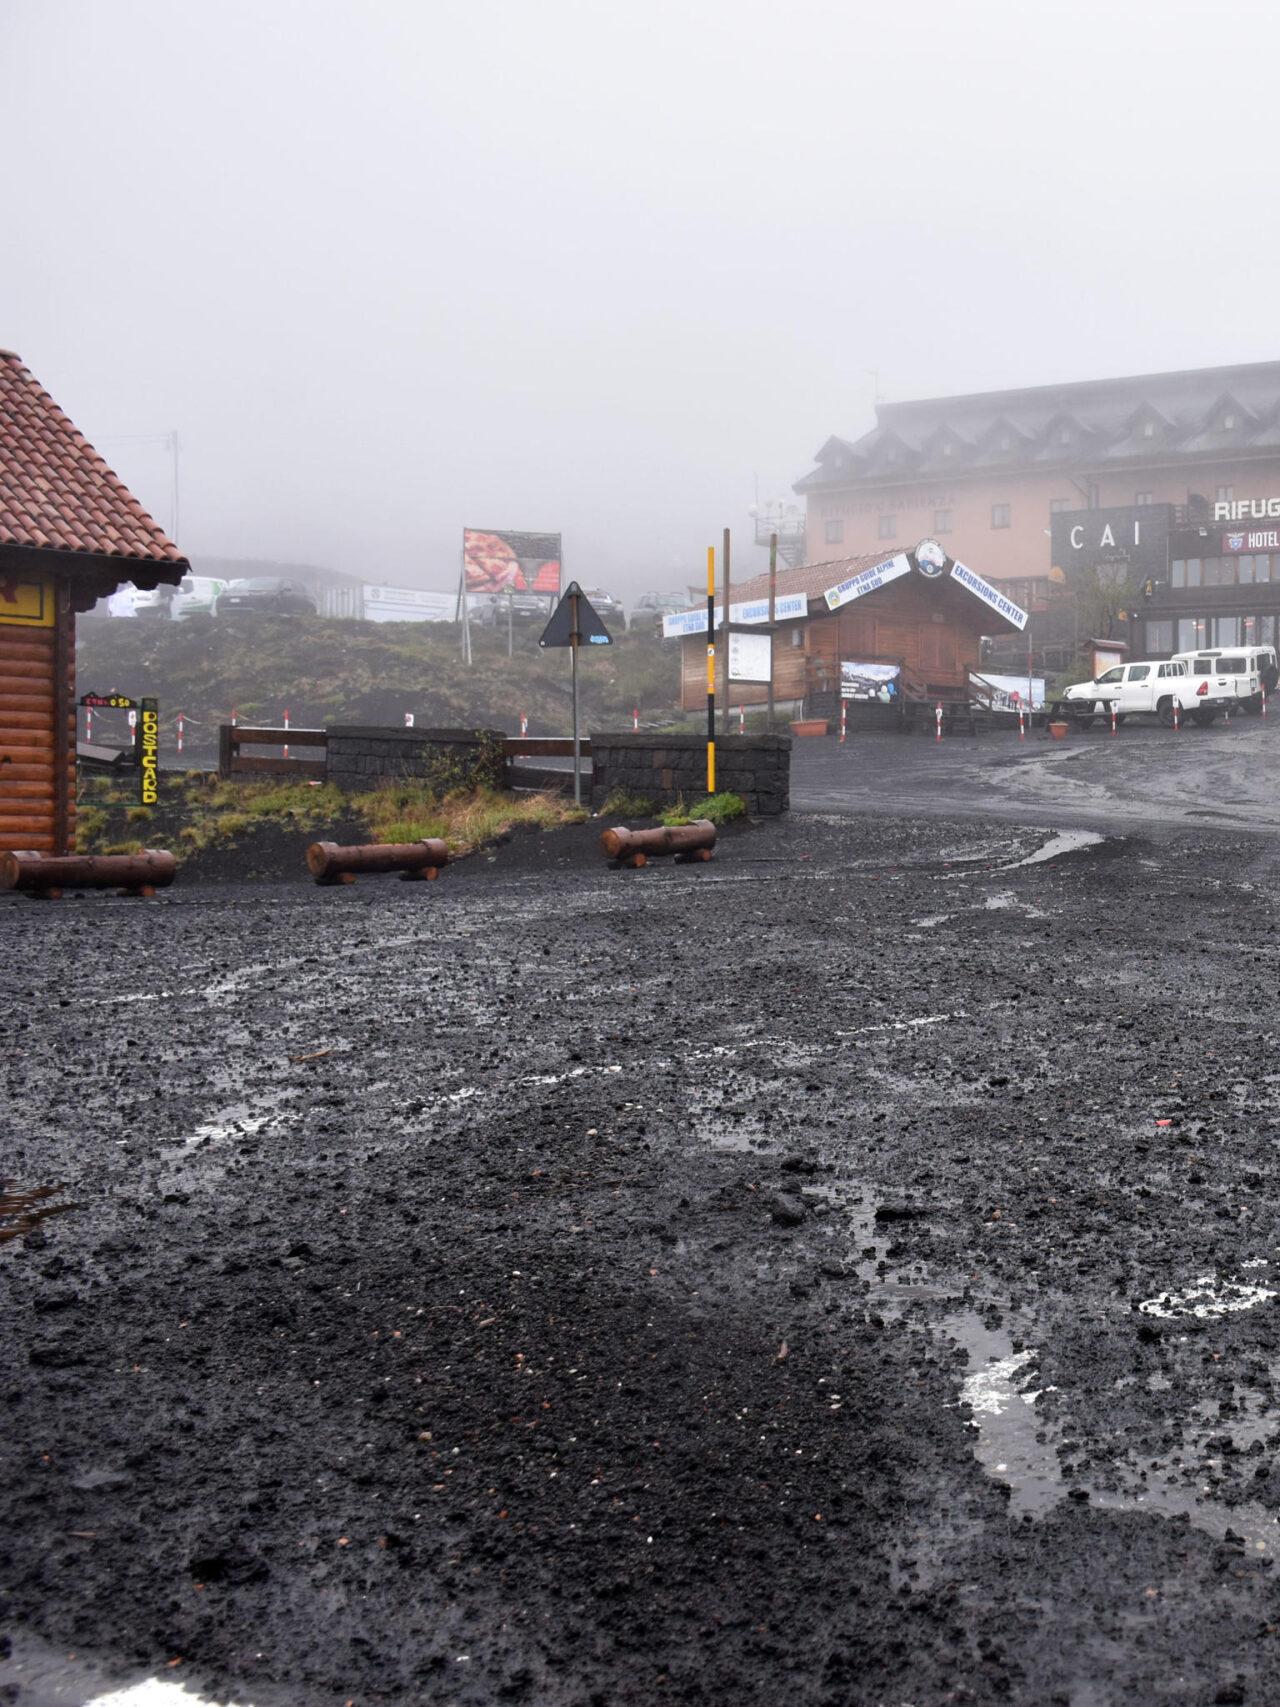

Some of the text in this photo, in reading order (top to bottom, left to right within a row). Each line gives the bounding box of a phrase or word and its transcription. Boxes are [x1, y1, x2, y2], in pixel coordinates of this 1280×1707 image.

[1249, 531, 1279, 548] HOTEL
[837, 560, 895, 593] GRUPPO GUIDE ALPINE
[857, 577, 882, 595] ETNA SUD
[955, 565, 1024, 623] EXCURSIONS CENTER
[142, 711, 158, 803] POSTCARD
